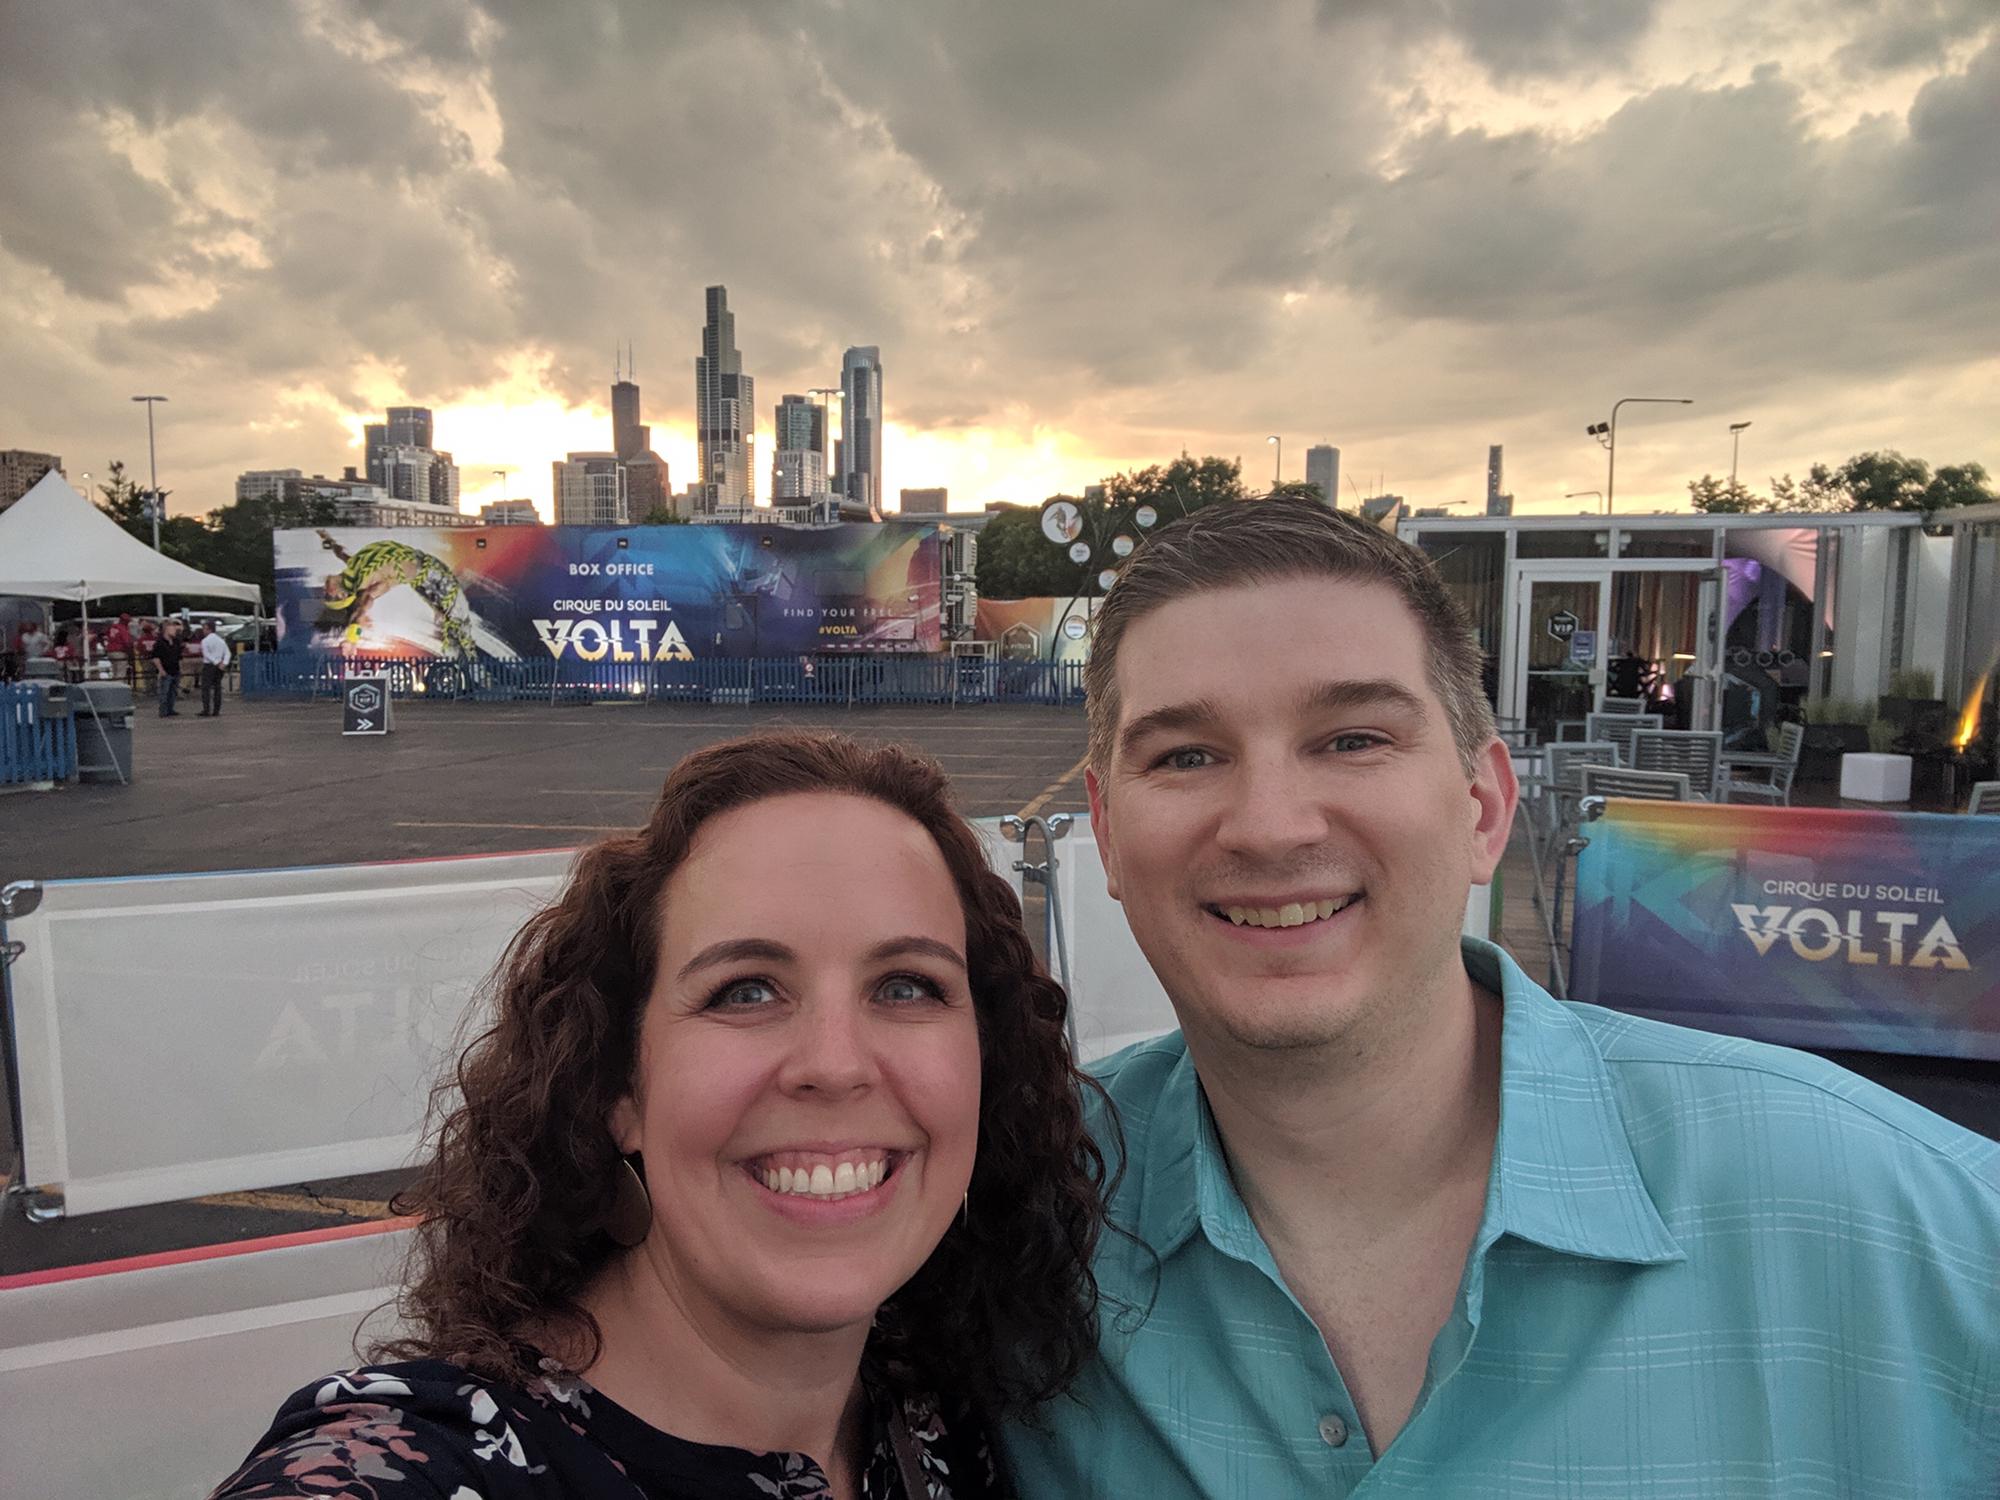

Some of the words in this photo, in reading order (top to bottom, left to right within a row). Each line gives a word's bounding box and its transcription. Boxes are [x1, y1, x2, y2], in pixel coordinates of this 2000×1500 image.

[568, 563, 601, 575] BOX
[605, 563, 655, 575] OFFICE
[553, 599, 602, 614] CIRQUE
[604, 600, 624, 611] DU
[627, 600, 672, 611] SOLEIL
[783, 608, 814, 617] FIND
[821, 608, 856, 617] YOUR
[818, 625, 858, 635] #VOLTA
[1553, 623, 1574, 632] VIP
[532, 619, 695, 662] VOLTA
[1763, 879, 1838, 901] CIRQUE
[1842, 884, 1870, 899] DU
[1875, 885, 1945, 904] SOLEIL
[1730, 903, 1972, 970] VOLTA
